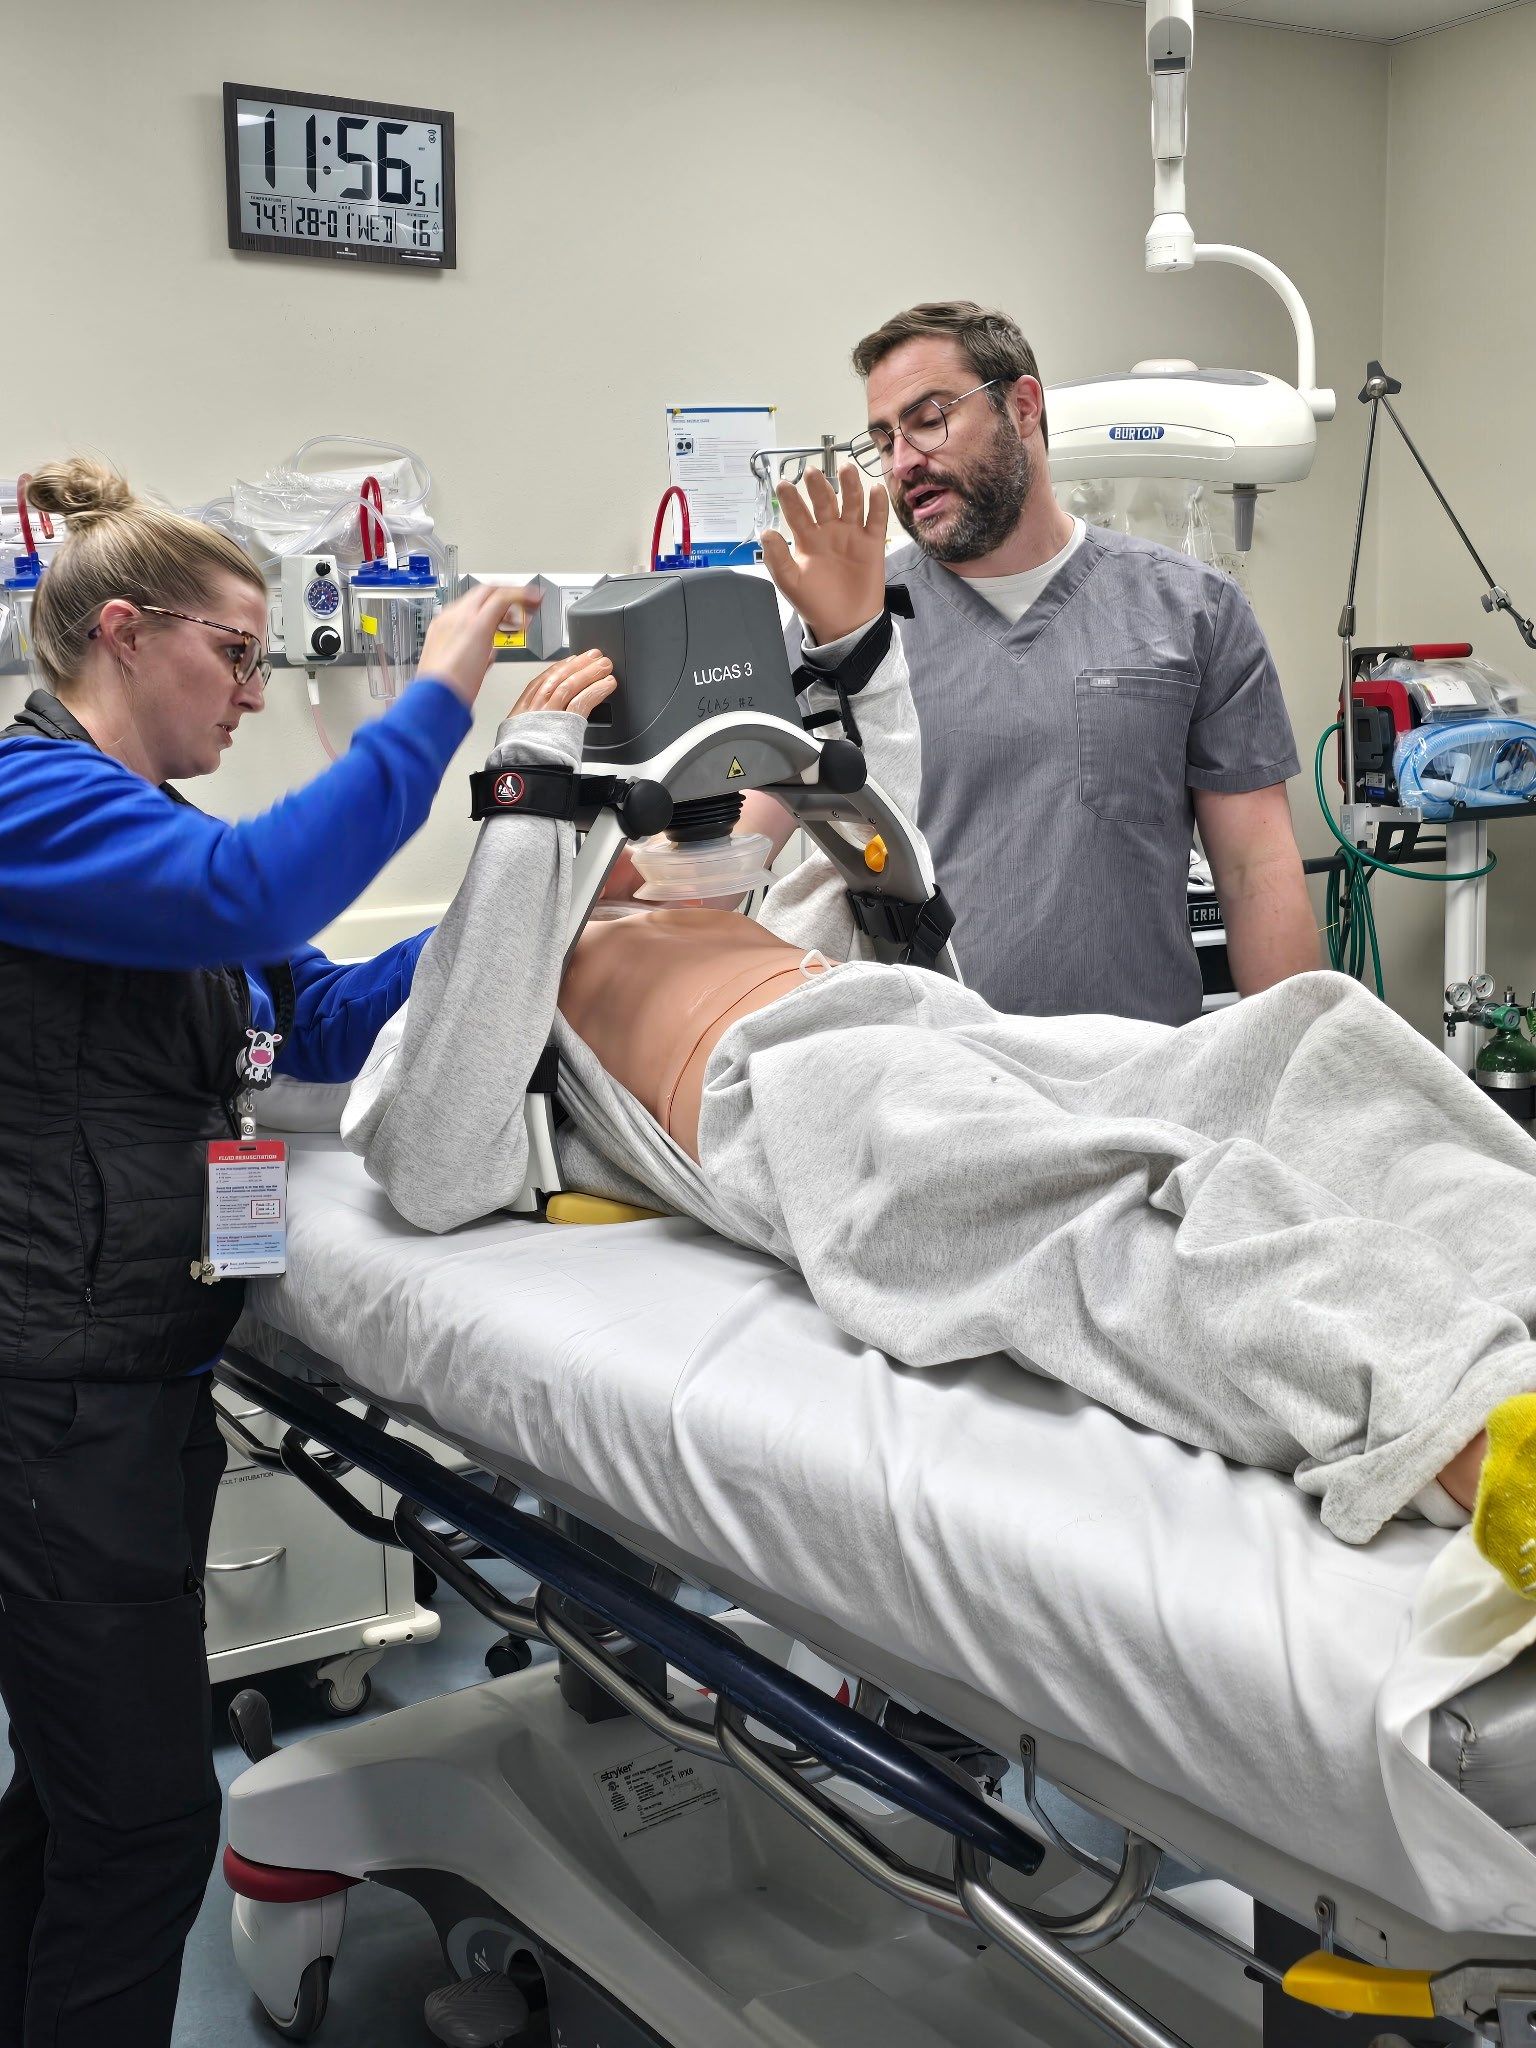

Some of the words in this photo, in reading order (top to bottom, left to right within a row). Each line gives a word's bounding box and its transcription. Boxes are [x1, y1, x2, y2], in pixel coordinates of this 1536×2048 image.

[264, 108, 412, 205] 11:56
[1114, 427, 1160, 440] BURTON
[693, 663, 742, 686] LUCAS
[744, 662, 753, 677] 3
[1193, 907, 1220, 922] CRA
[600, 1762, 634, 1783] stryker
